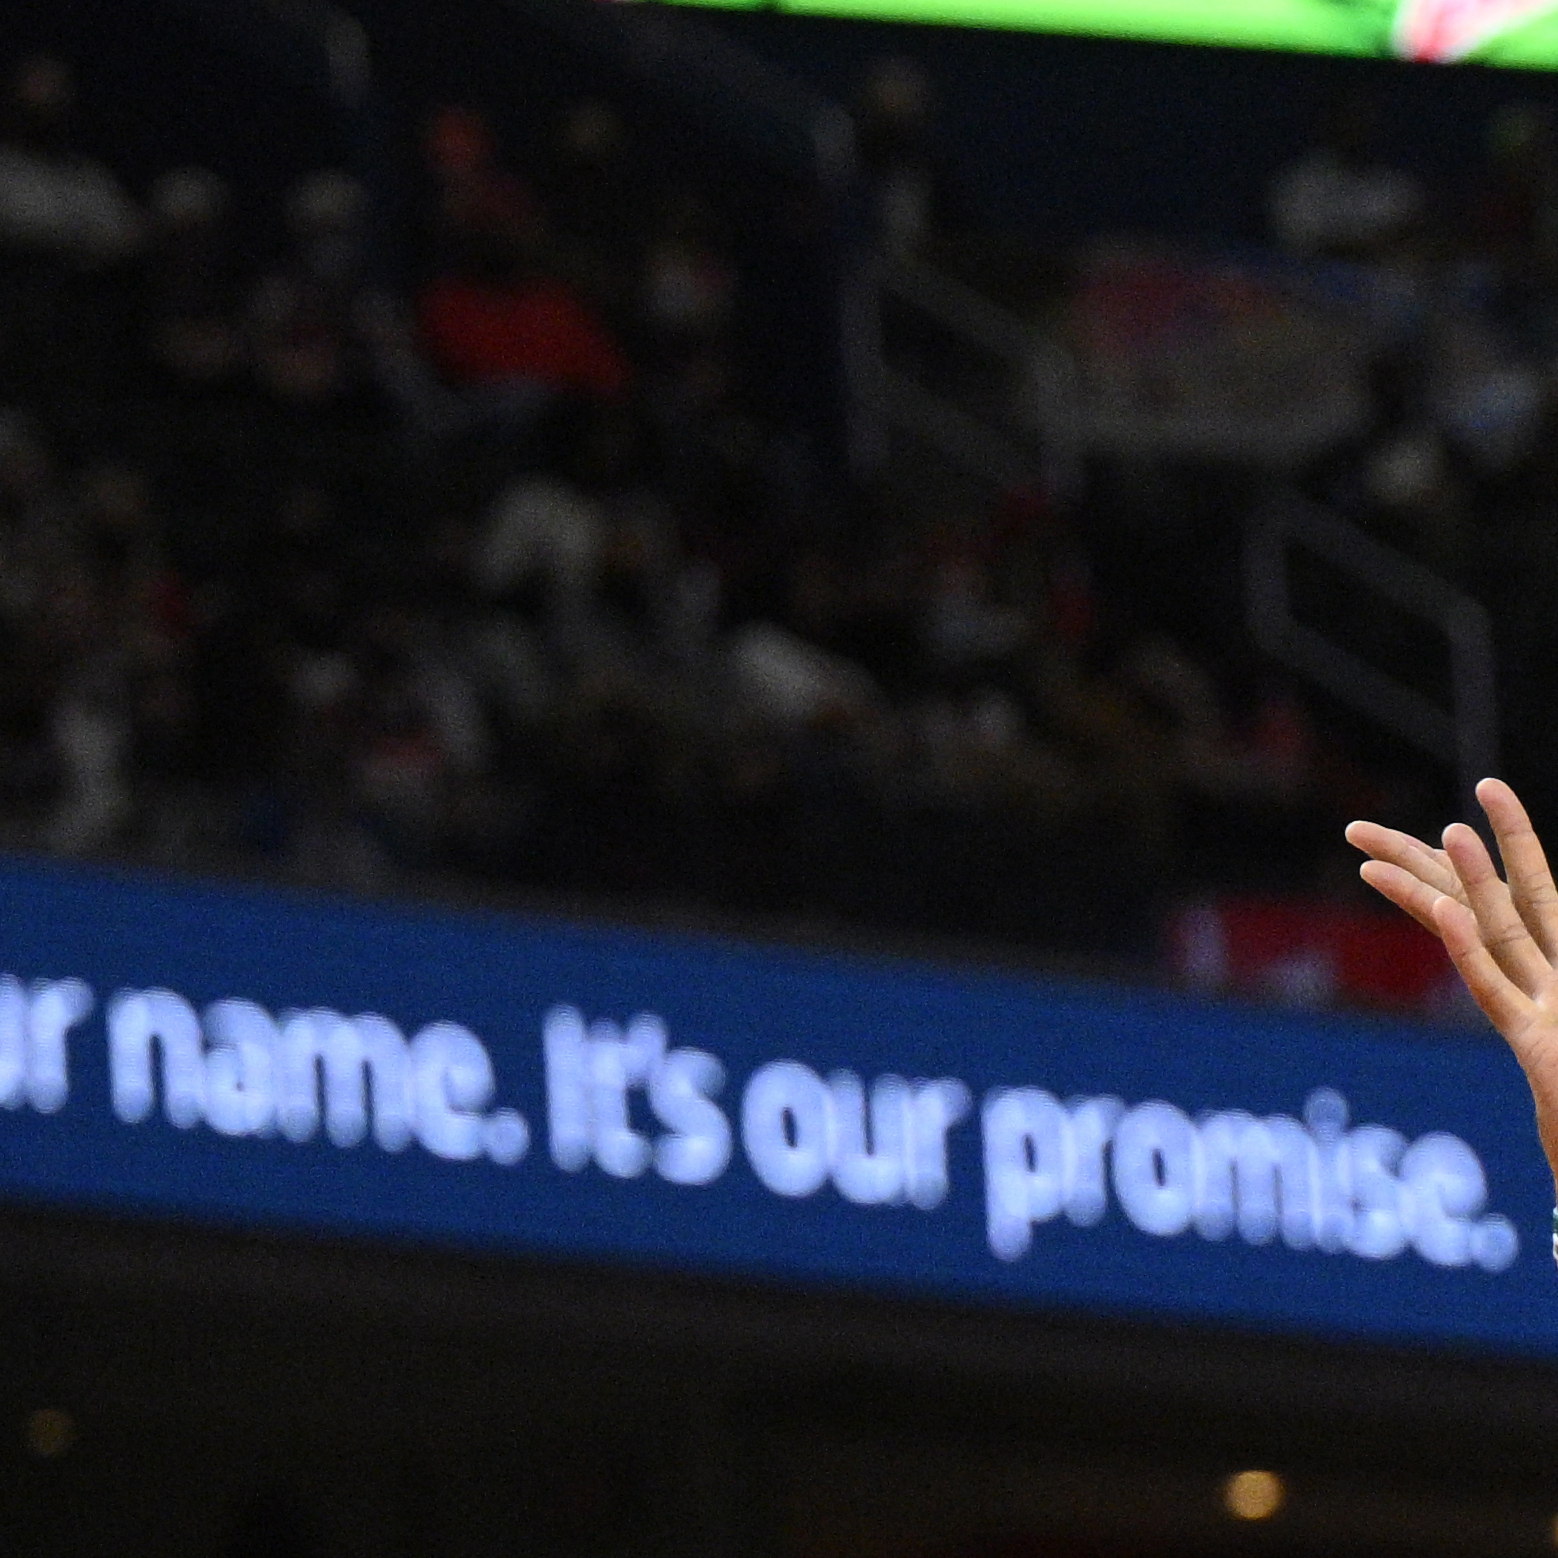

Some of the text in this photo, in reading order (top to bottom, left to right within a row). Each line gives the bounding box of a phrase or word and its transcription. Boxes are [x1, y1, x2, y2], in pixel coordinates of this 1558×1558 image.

[109, 986, 529, 1164] name.
[543, 1004, 733, 1185] It's
[742, 1060, 971, 1210] our
[981, 1085, 1519, 1273] promise.
